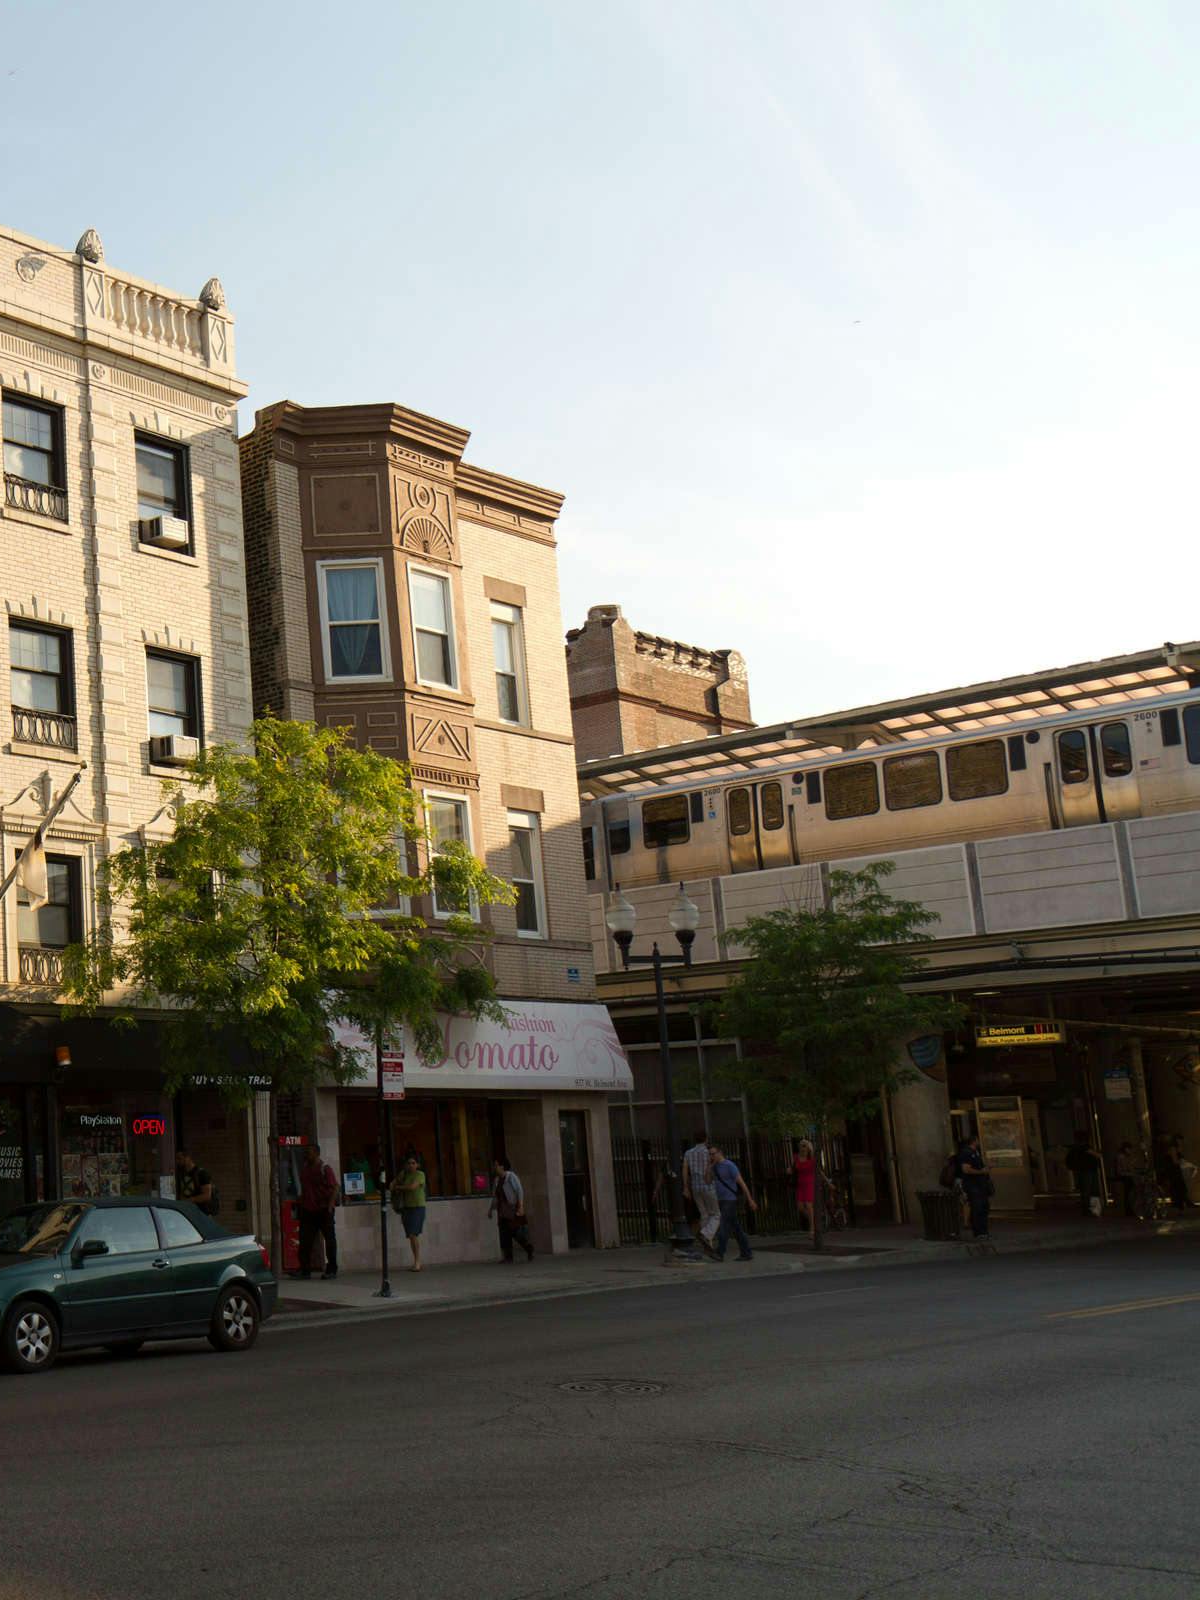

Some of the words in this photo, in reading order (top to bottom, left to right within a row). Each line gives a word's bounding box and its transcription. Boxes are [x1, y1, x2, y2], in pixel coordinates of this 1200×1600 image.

[1134, 711, 1158, 722] 2600
[989, 1026, 1026, 1036] Belmont
[191, 1075, 209, 1085] UY
[80, 1115, 122, 1128] PlayStation
[132, 1119, 165, 1136] OPEN
[286, 1135, 302, 1145] ATM
